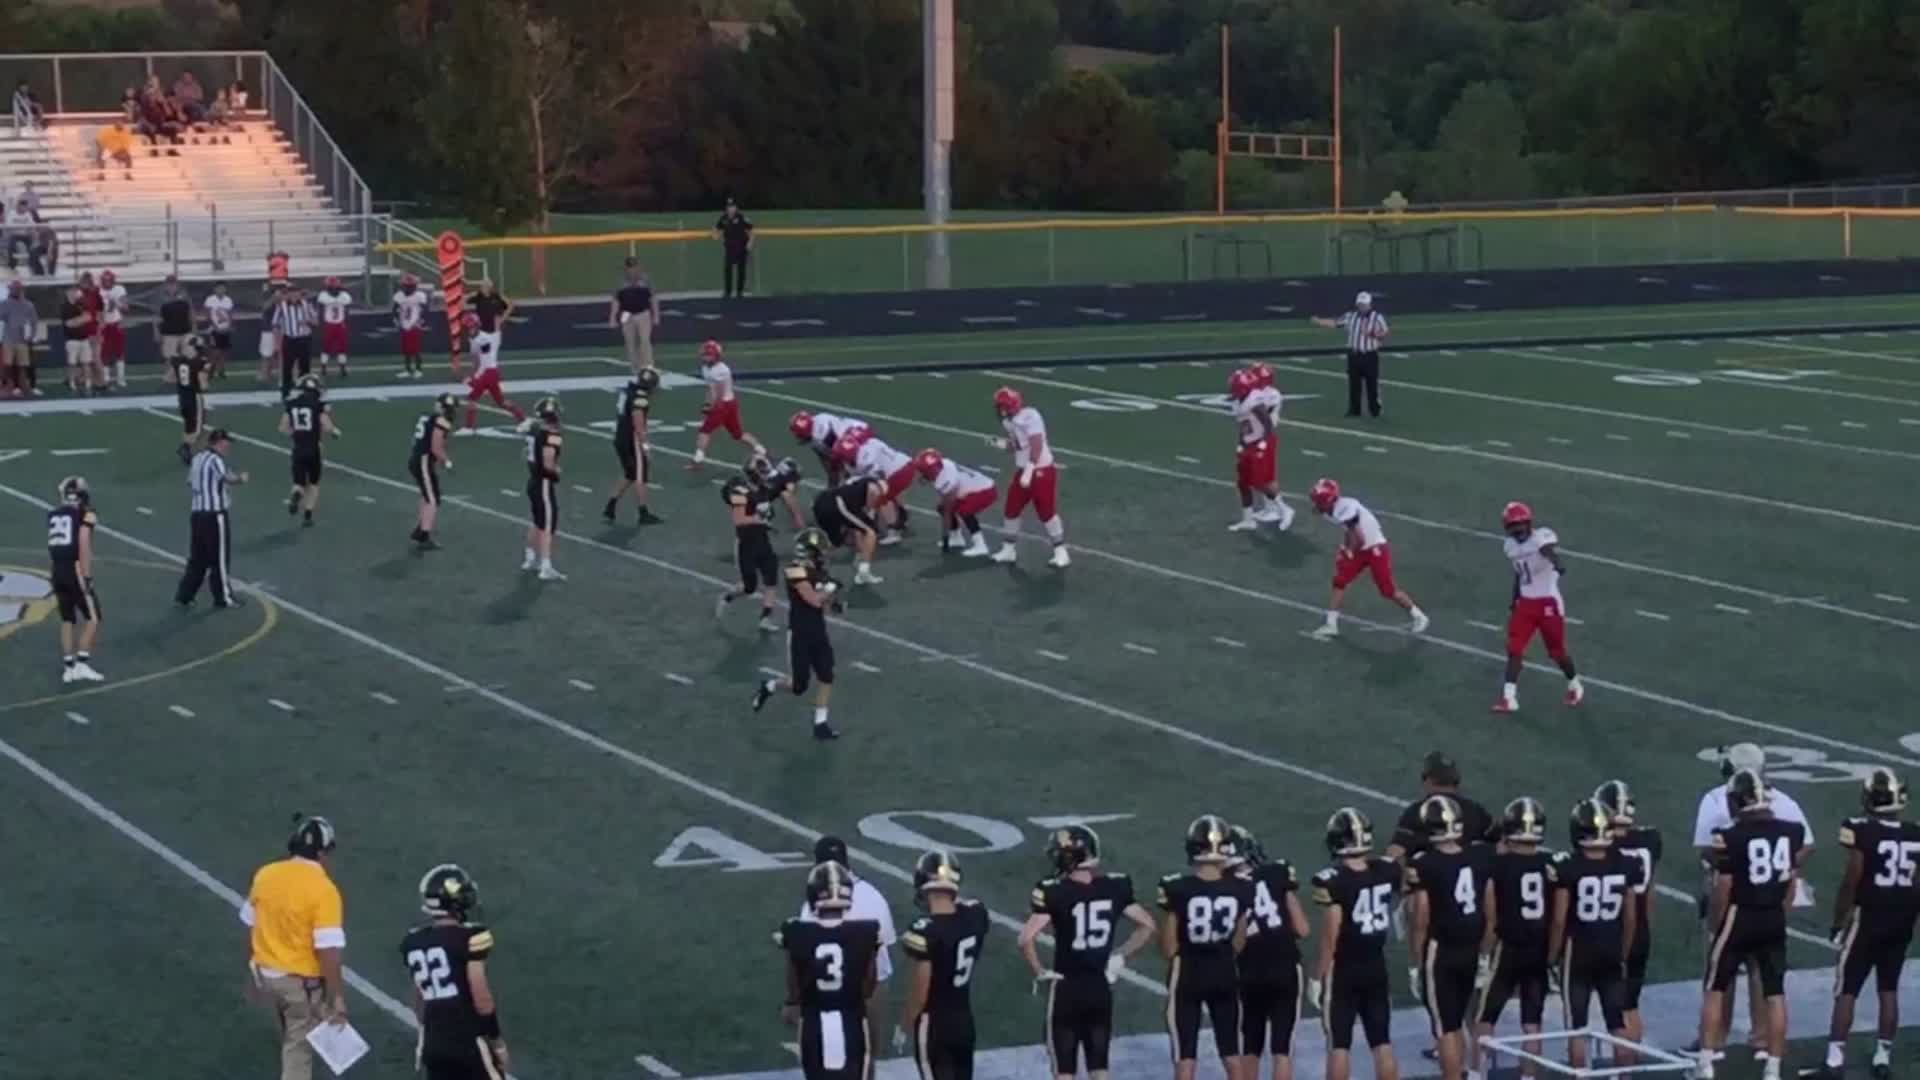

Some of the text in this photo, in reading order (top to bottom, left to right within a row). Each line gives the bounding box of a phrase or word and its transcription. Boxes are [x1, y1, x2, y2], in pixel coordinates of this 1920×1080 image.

[291, 407, 312, 431] 13
[48, 515, 72, 545] 29
[1747, 835, 1790, 884] 84
[1873, 840, 1920, 886] 35
[1352, 883, 1392, 934] 45
[1455, 866, 1475, 914] 4
[1520, 872, 1543, 919] 9
[1577, 874, 1626, 921] 85
[1071, 899, 1112, 951] 15
[1187, 895, 1238, 944] 83
[408, 946, 458, 1001] 22
[815, 943, 843, 991] 3
[953, 935, 977, 988] 5
